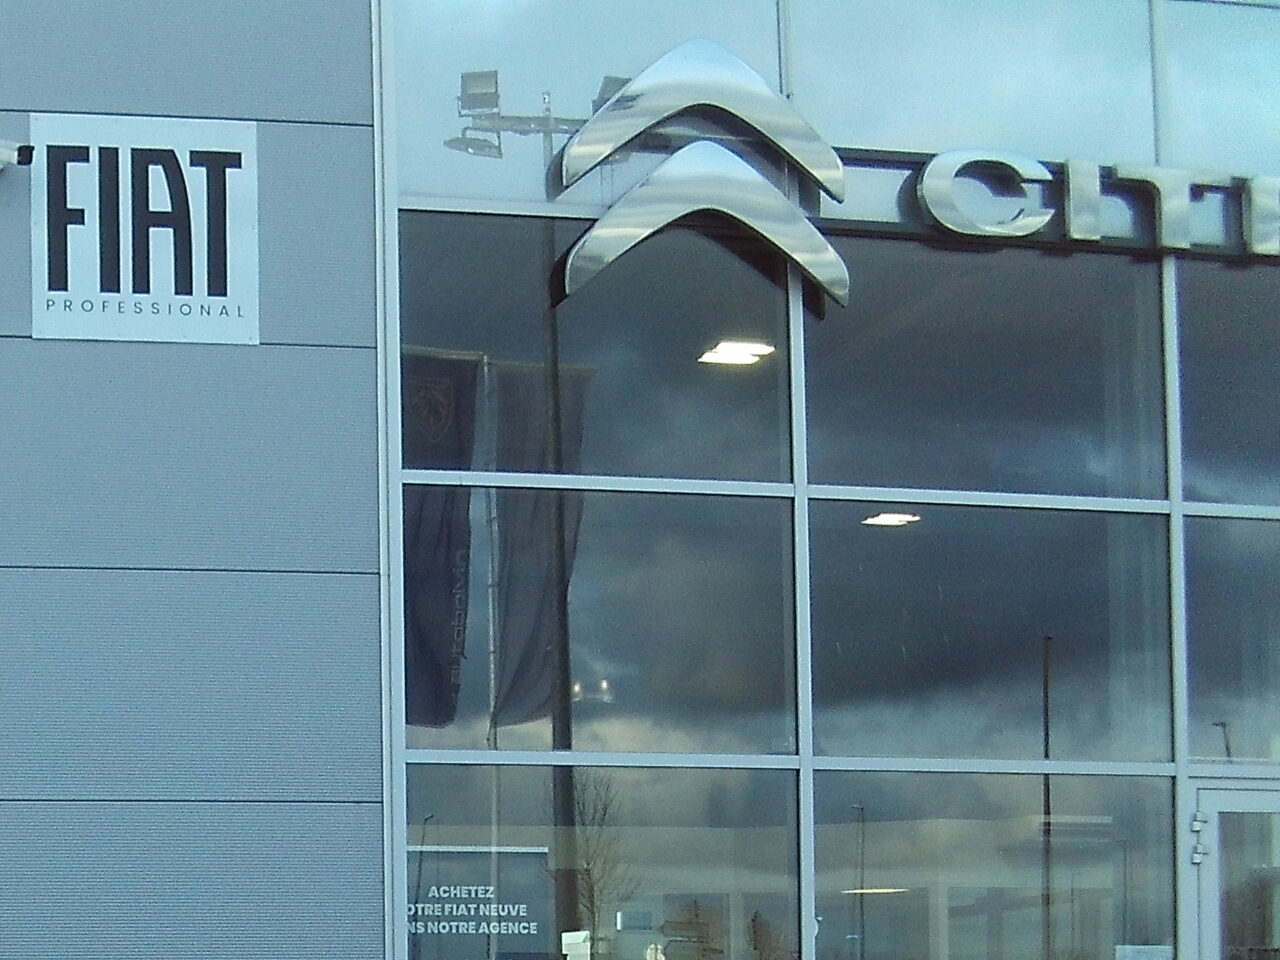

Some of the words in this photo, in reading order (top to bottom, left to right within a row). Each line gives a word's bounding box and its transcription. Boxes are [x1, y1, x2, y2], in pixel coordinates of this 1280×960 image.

[46, 144, 242, 298] FIAT
[46, 299, 244, 318] PROFESSIONAL
[428, 886, 495, 898] ACHETEZ
[407, 903, 442, 916] OTRE
[444, 903, 478, 916] FIAT
[480, 904, 527, 917] NEUVE
[407, 921, 425, 934] NS
[427, 921, 476, 934] NOTRE
[478, 922, 538, 935] AGENCE
